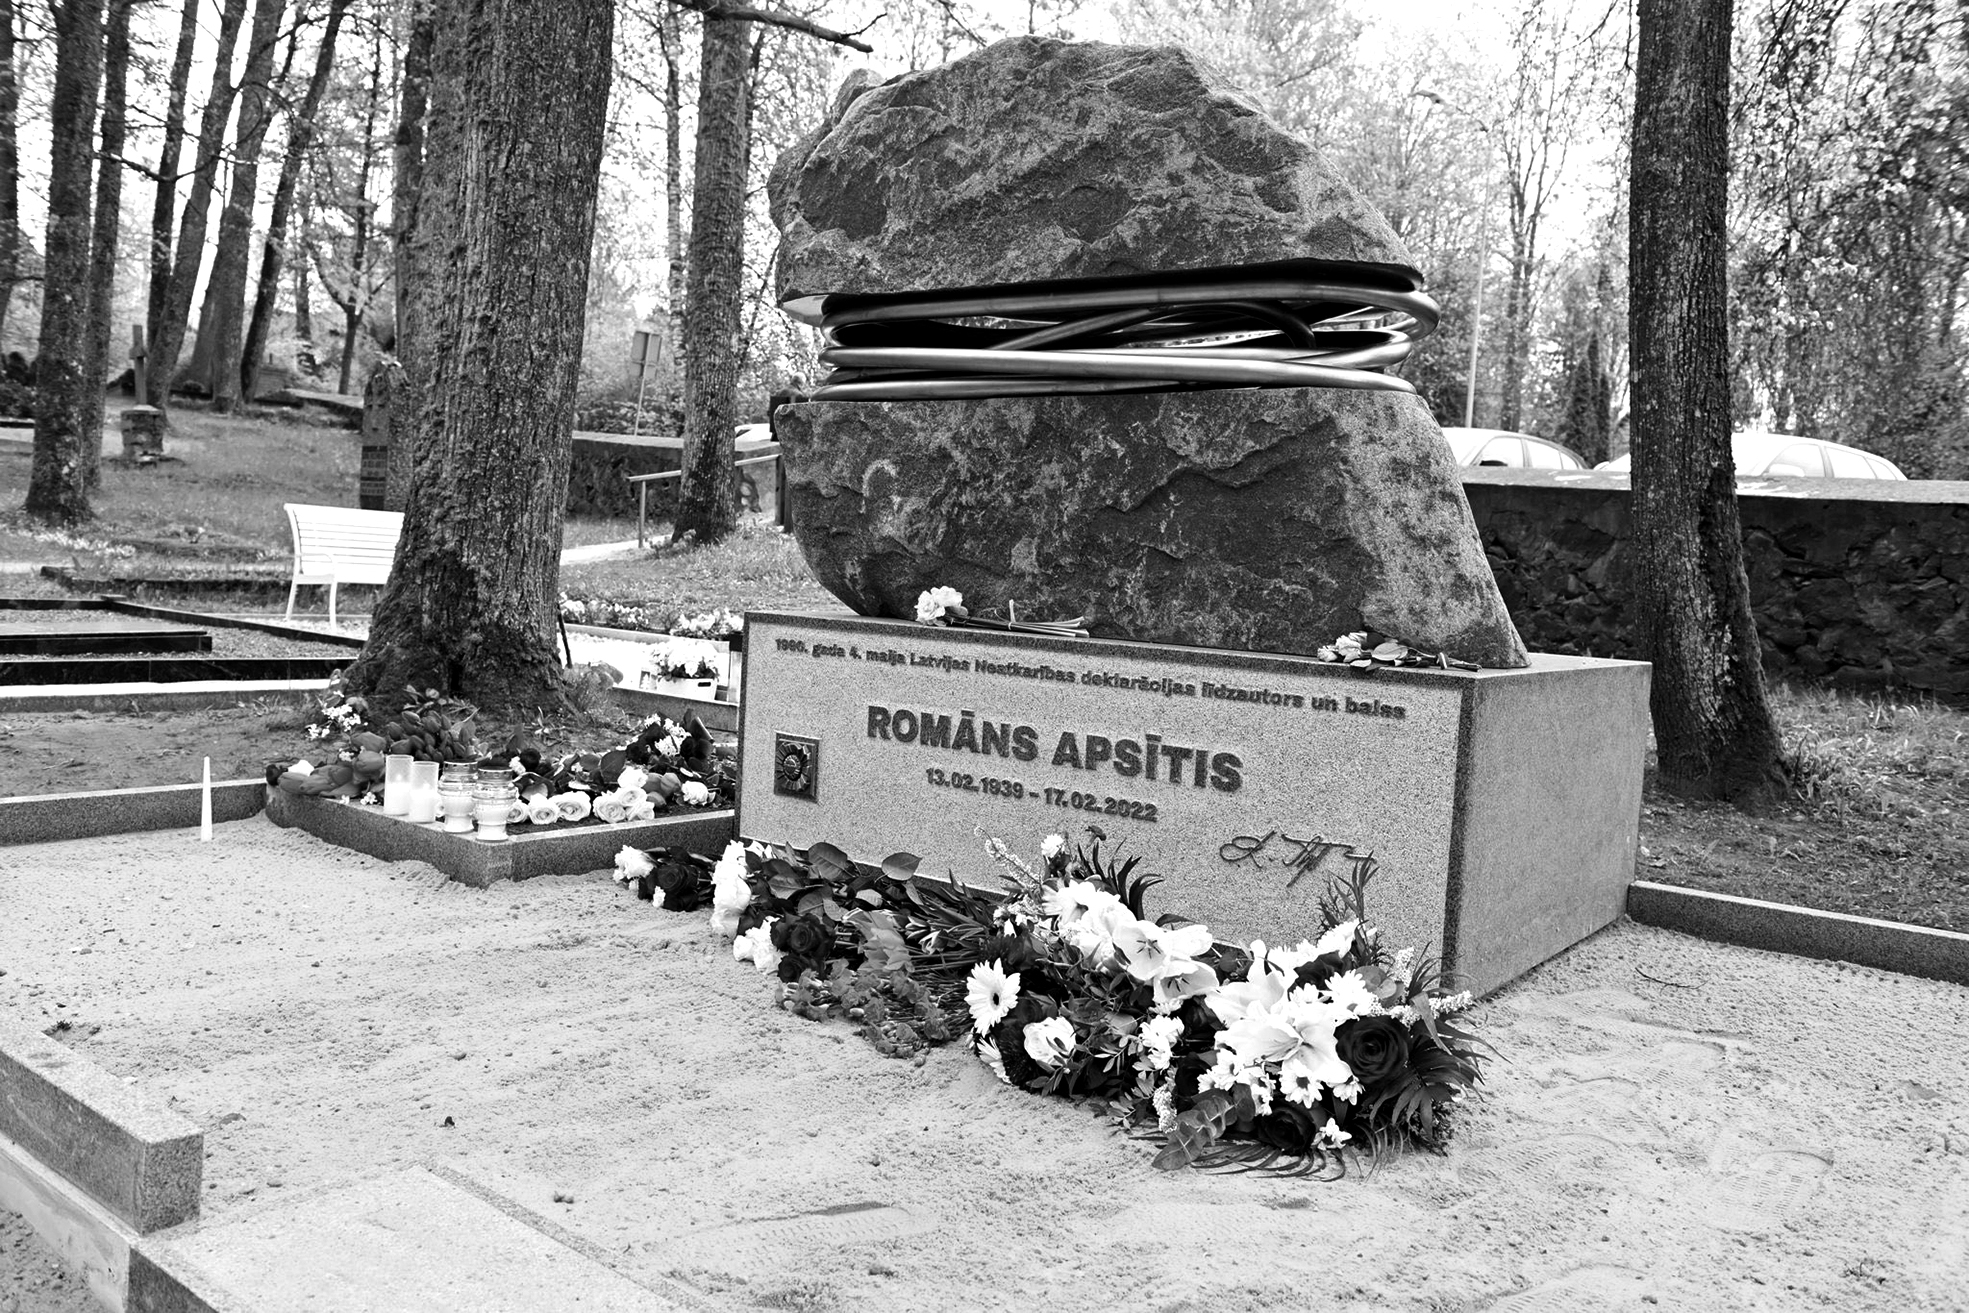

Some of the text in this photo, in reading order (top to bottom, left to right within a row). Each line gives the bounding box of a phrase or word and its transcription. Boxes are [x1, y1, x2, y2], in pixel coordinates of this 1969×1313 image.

[812, 643, 845, 658] gada
[849, 647, 862, 660] 4.
[866, 649, 905, 666] maija
[909, 652, 970, 673] Latvijas
[975, 658, 1075, 684] Neatkarības
[1081, 670, 1196, 697] deklarācijas
[1201, 681, 1304, 708] līdzautors
[1311, 697, 1337, 713] un
[1345, 697, 1406, 720] balss
[867, 705, 1244, 793] ROMĀNS APSĪTIS
[926, 767, 1023, 800] 13.02.1939
[1044, 787, 1158, 822] 17.02.2022
